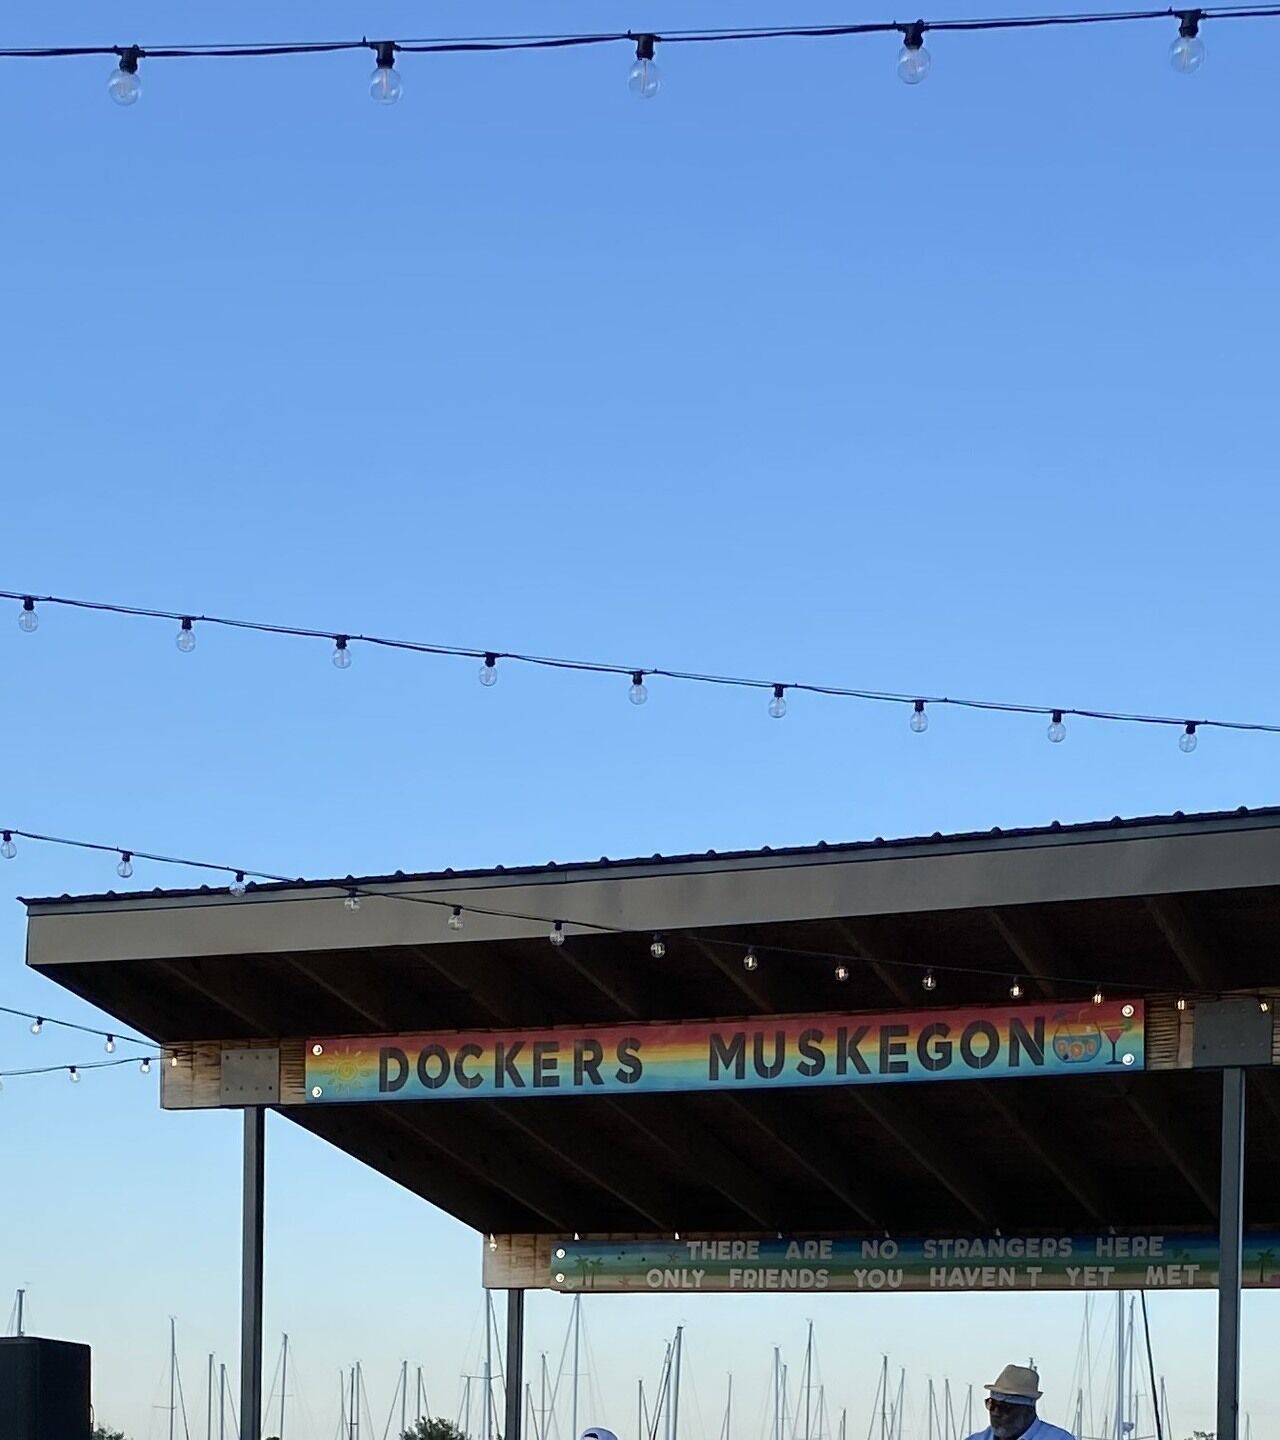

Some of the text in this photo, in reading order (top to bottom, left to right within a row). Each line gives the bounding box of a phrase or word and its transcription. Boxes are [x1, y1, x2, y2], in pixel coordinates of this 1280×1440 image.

[378, 1016, 1045, 1092] DOCKERS MUSKEGON
[687, 1236, 1165, 1260] THERE ARE NO STRANGERS HERE
[646, 1268, 705, 1289] ONLY
[729, 1268, 829, 1288] FRIENDS
[853, 1268, 903, 1288] YOU
[1065, 1266, 1116, 1287] YET
[1145, 1264, 1200, 1286] MET
